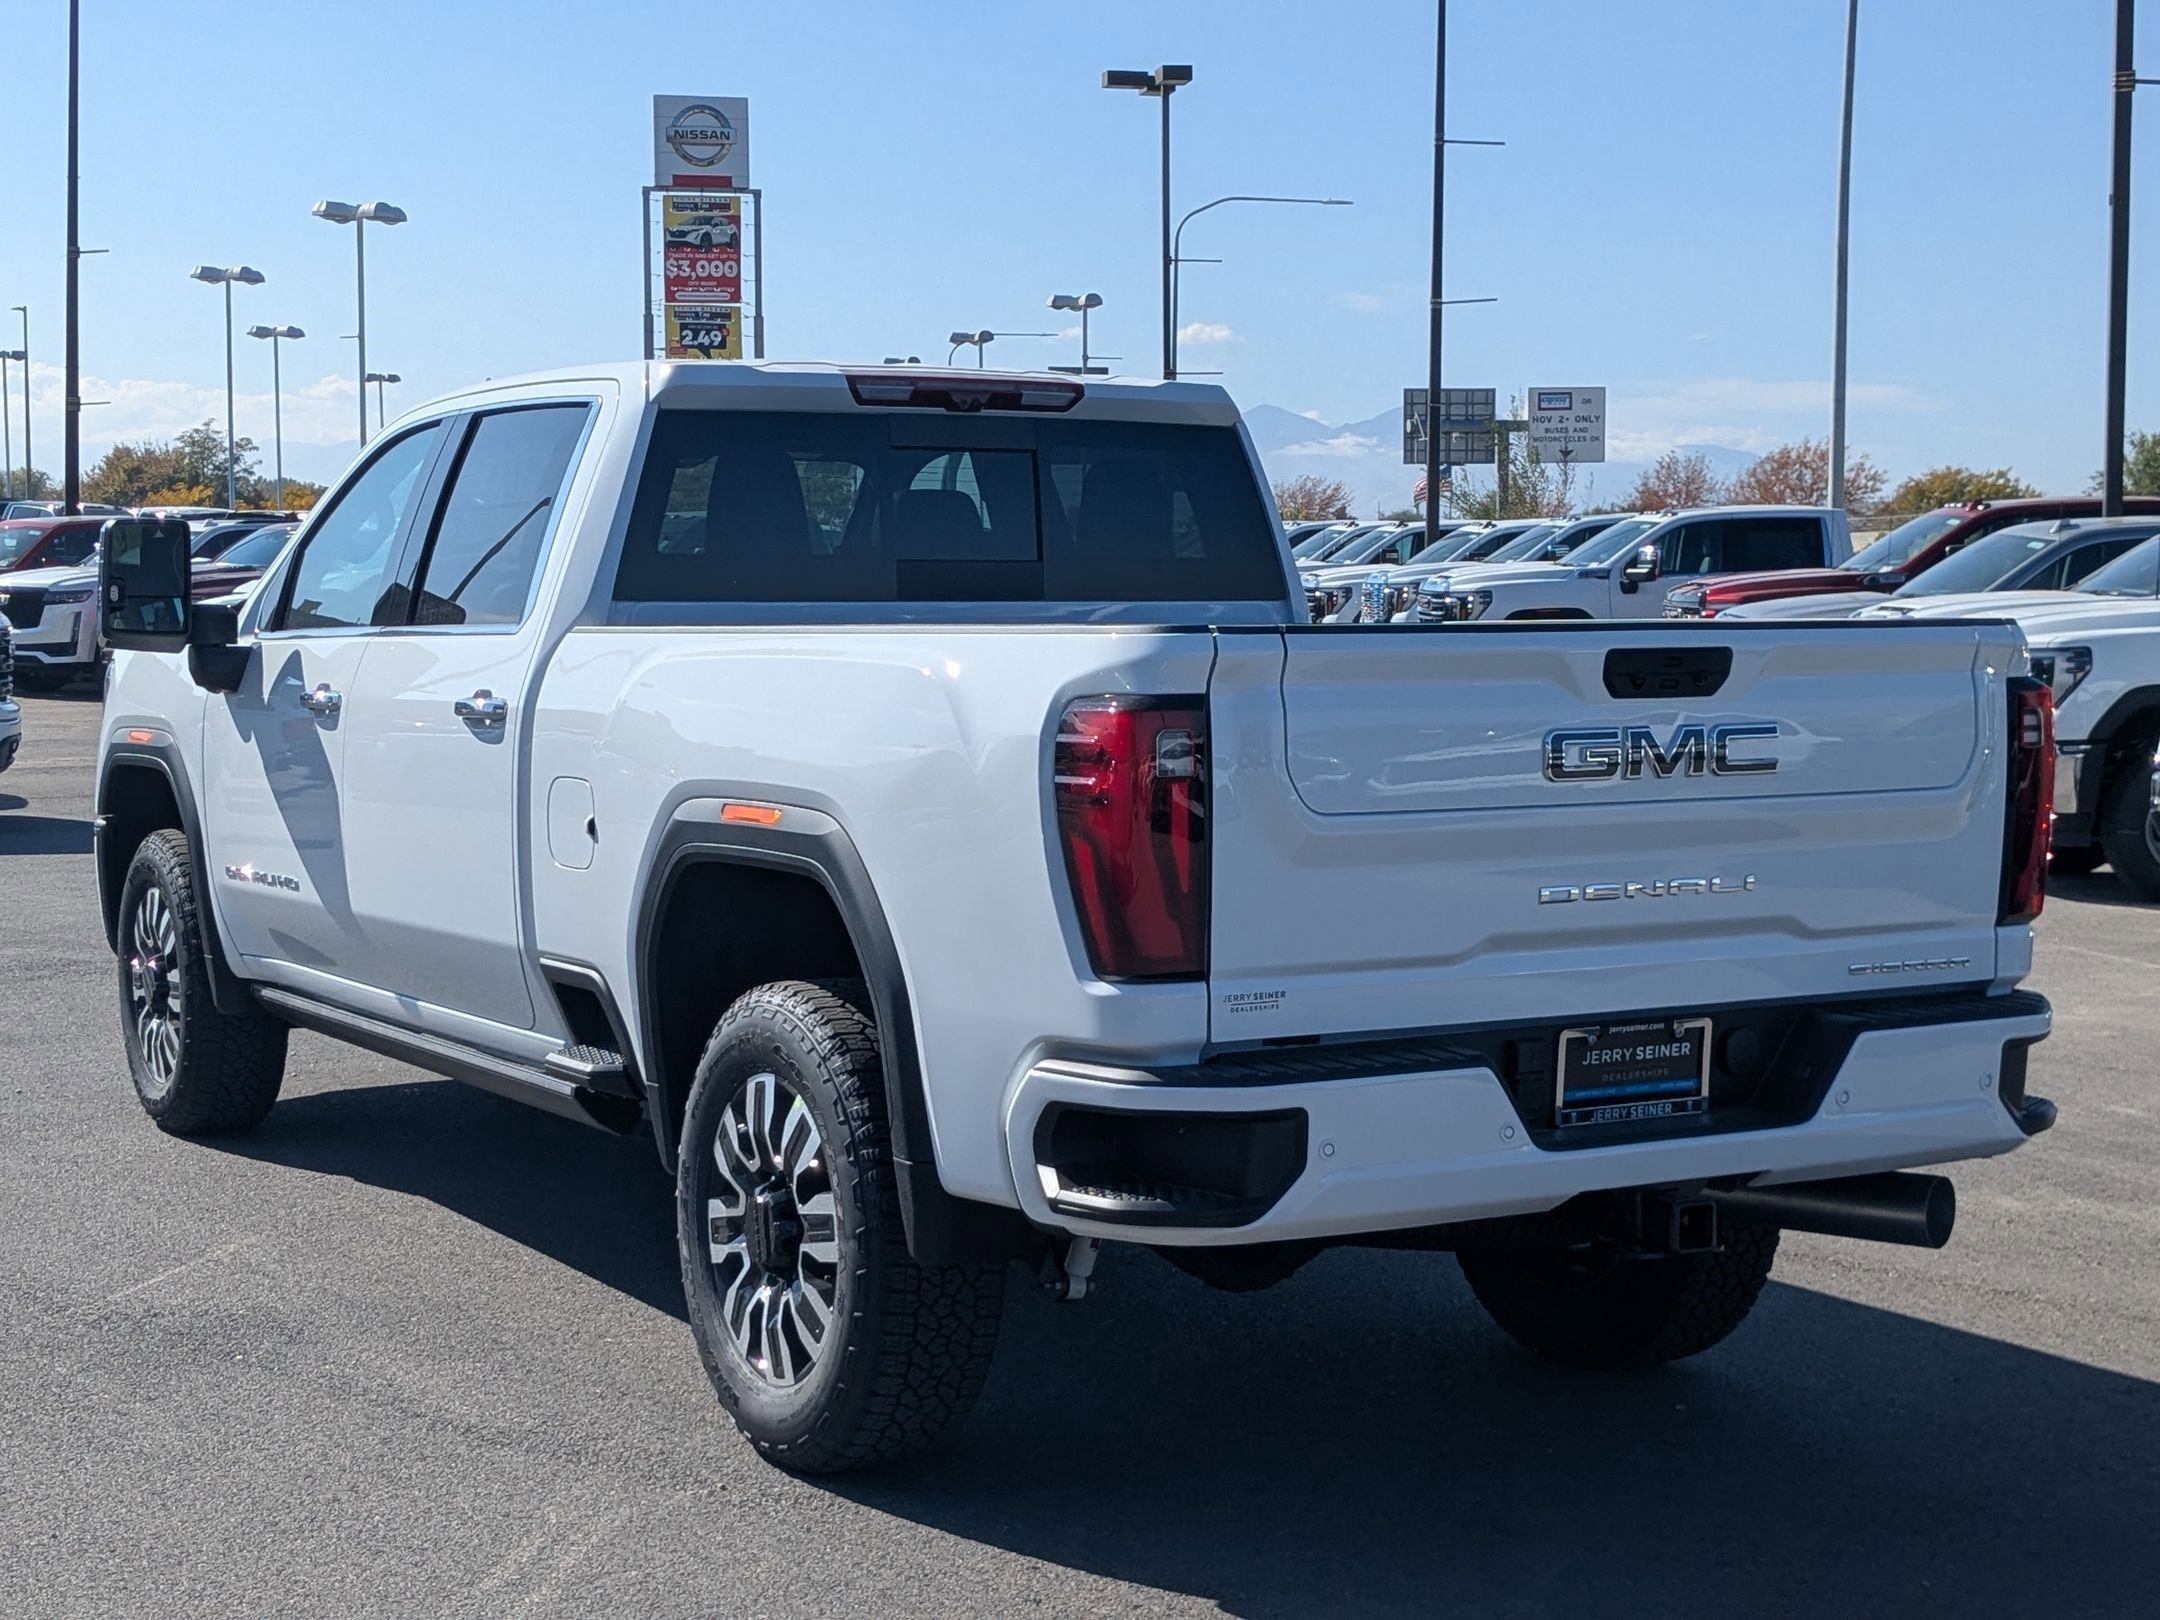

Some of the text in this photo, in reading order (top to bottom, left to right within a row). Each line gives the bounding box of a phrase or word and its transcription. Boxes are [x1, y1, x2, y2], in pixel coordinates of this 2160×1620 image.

[673, 128, 730, 141] NISSAN
[665, 258, 738, 280] $3,000
[681, 329, 722, 346] 2.49
[1532, 415, 1552, 424] HOV
[1575, 415, 1600, 424] ONLY
[1532, 435, 1587, 443] MOTORCYCLES
[1542, 722, 1779, 783] GMC
[1538, 874, 1756, 905] DENALI
[1848, 956, 1970, 976] SIERRA
[1222, 990, 1286, 1003] JERRY SEINER
[1230, 1003, 1279, 1013] DEALERSHIPS
[1608, 1022, 1665, 1034] jerryseiner.com
[1582, 1042, 1691, 1065] JERRY SEINER
[1602, 1067, 1669, 1082] DEALERSHIPS
[1590, 1103, 1672, 1122] JERRY SEINER
